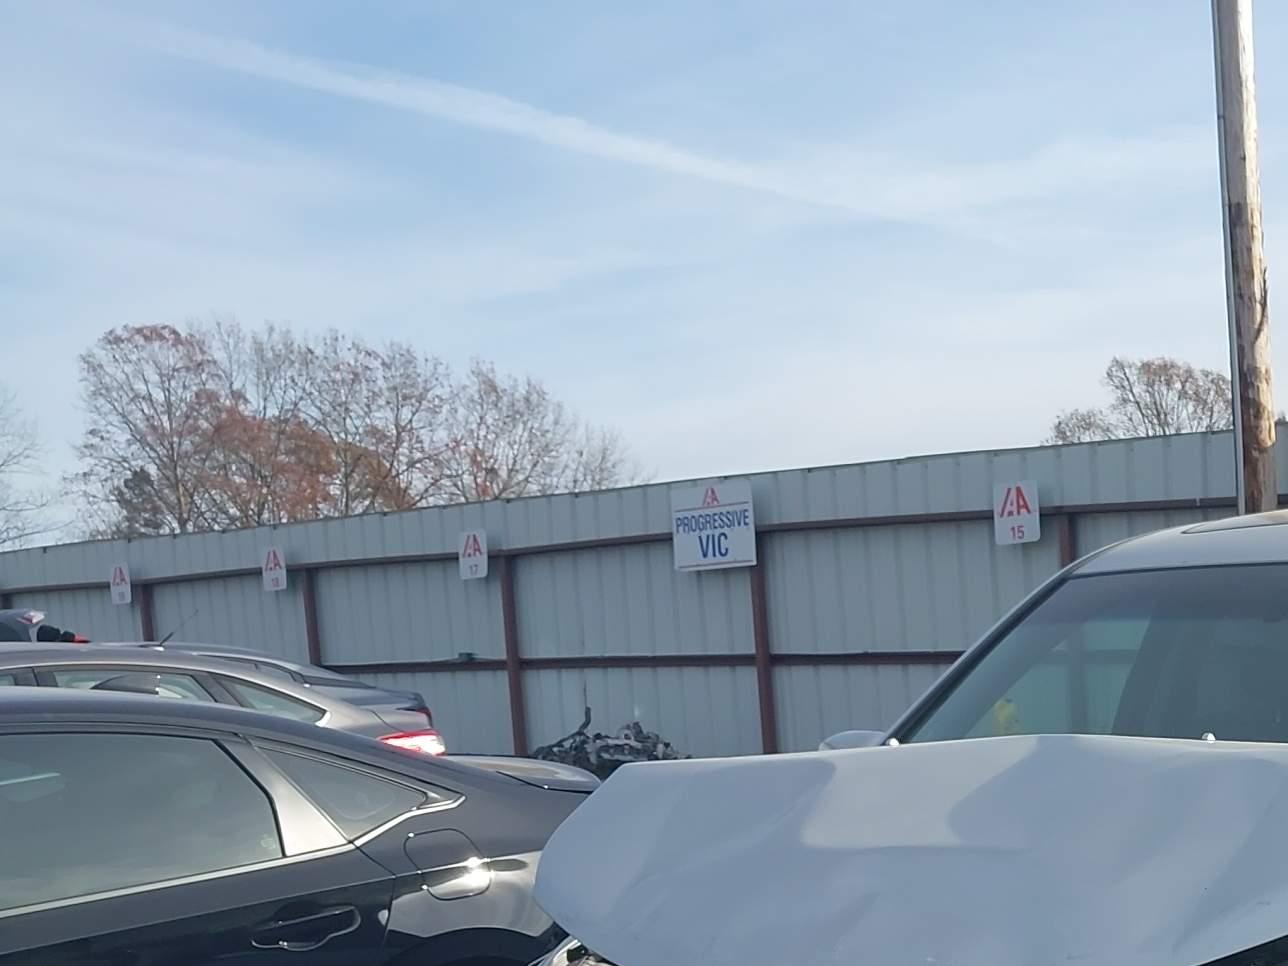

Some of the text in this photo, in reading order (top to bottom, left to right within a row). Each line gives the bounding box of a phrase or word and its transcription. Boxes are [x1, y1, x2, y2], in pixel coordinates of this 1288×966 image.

[675, 509, 750, 534] PROGRESSIVE
[1009, 525, 1025, 541] 15
[698, 532, 729, 559] VIC
[468, 563, 479, 576] 17
